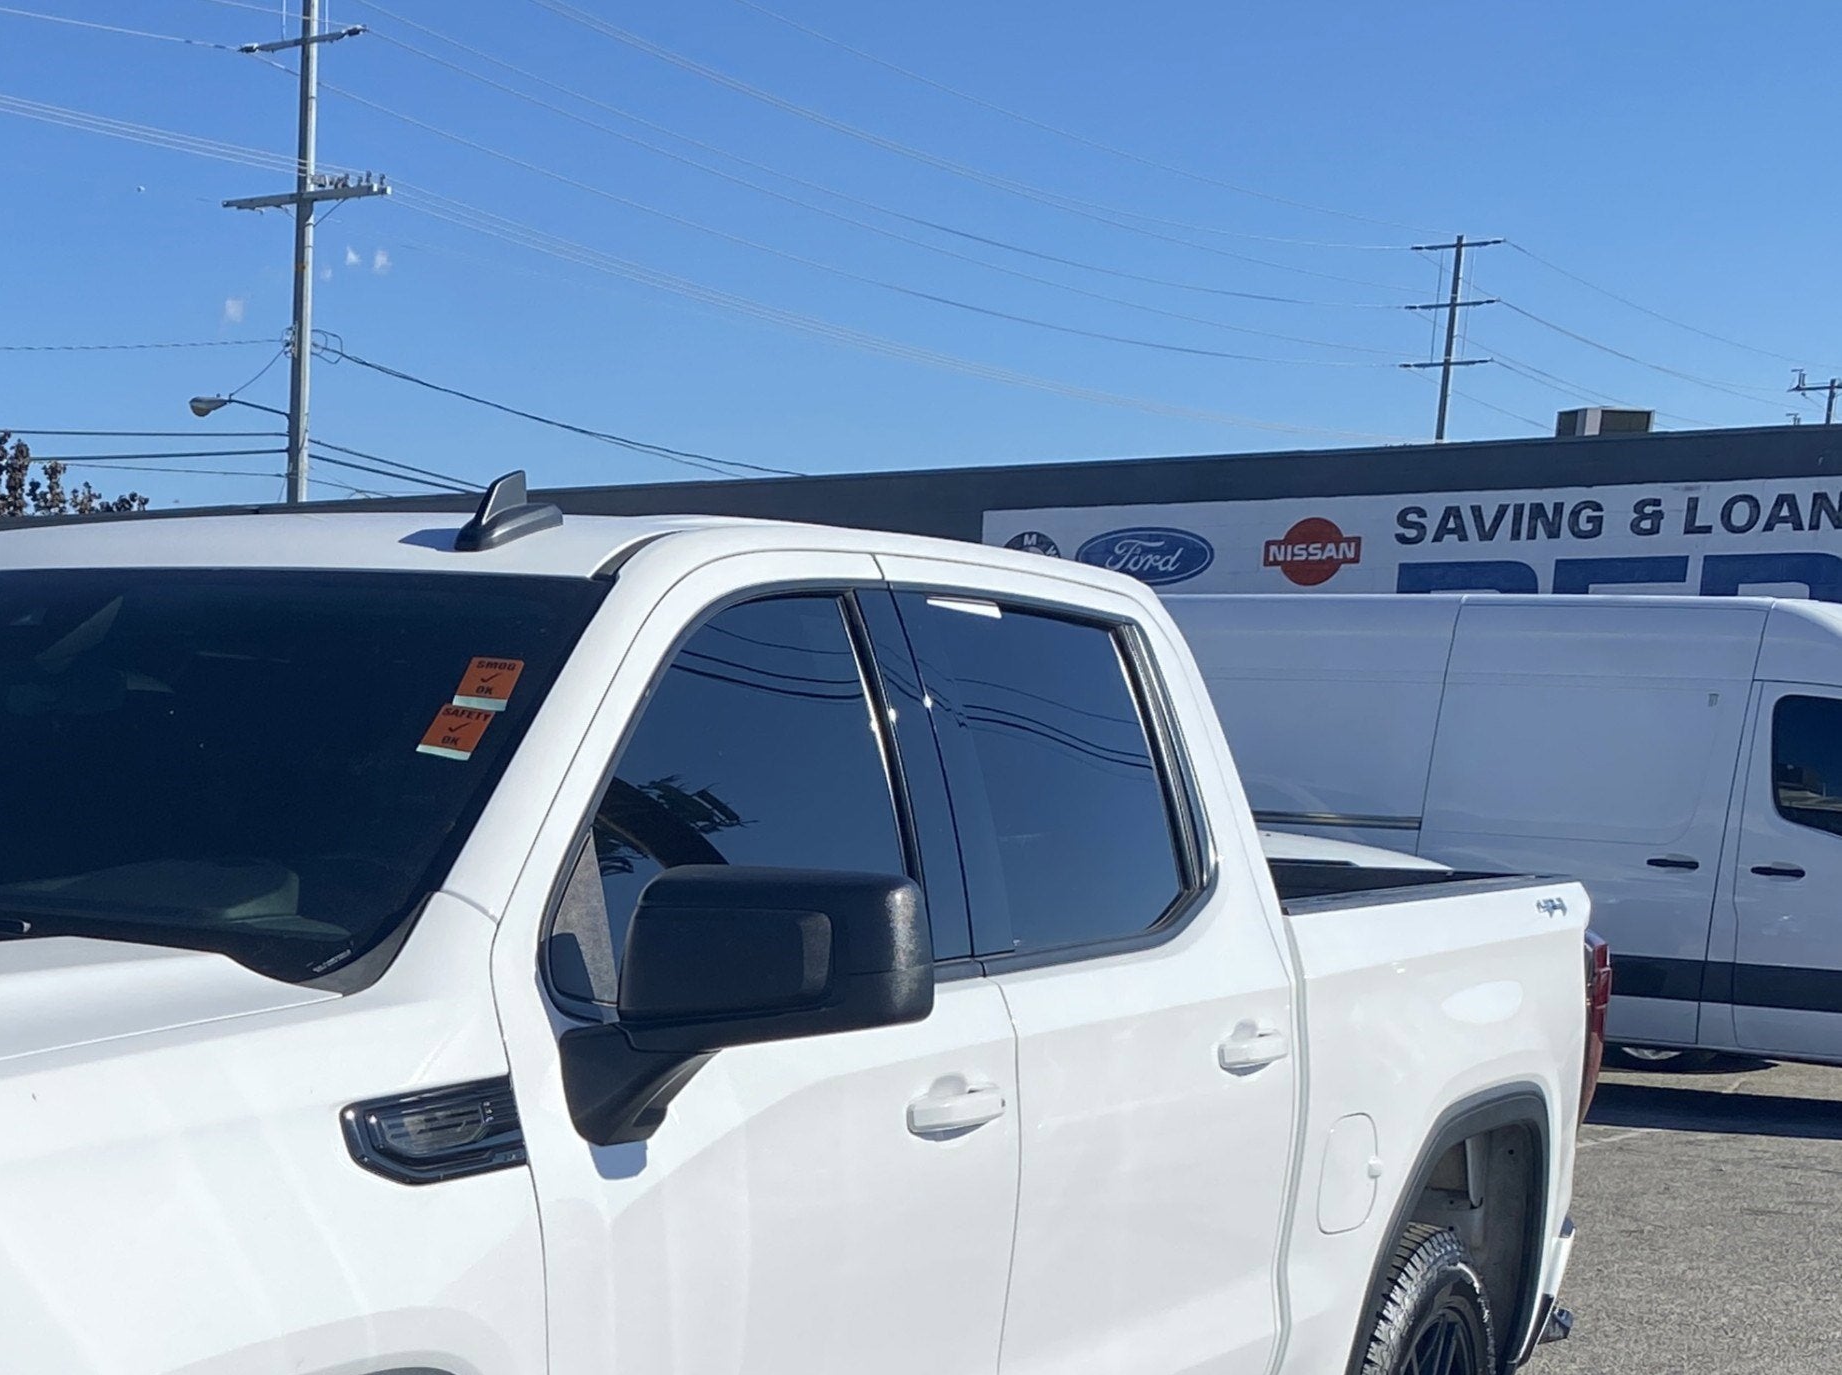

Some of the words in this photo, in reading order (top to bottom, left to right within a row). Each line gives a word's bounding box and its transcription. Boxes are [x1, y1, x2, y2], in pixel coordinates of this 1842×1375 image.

[1394, 500, 1605, 545] SAVING
[1630, 497, 1665, 537] &
[1105, 538, 1184, 573] Ford
[1268, 541, 1357, 563] NISSAN
[475, 685, 495, 696] OK
[441, 707, 493, 722] SAFETY
[441, 735, 462, 747] OK
